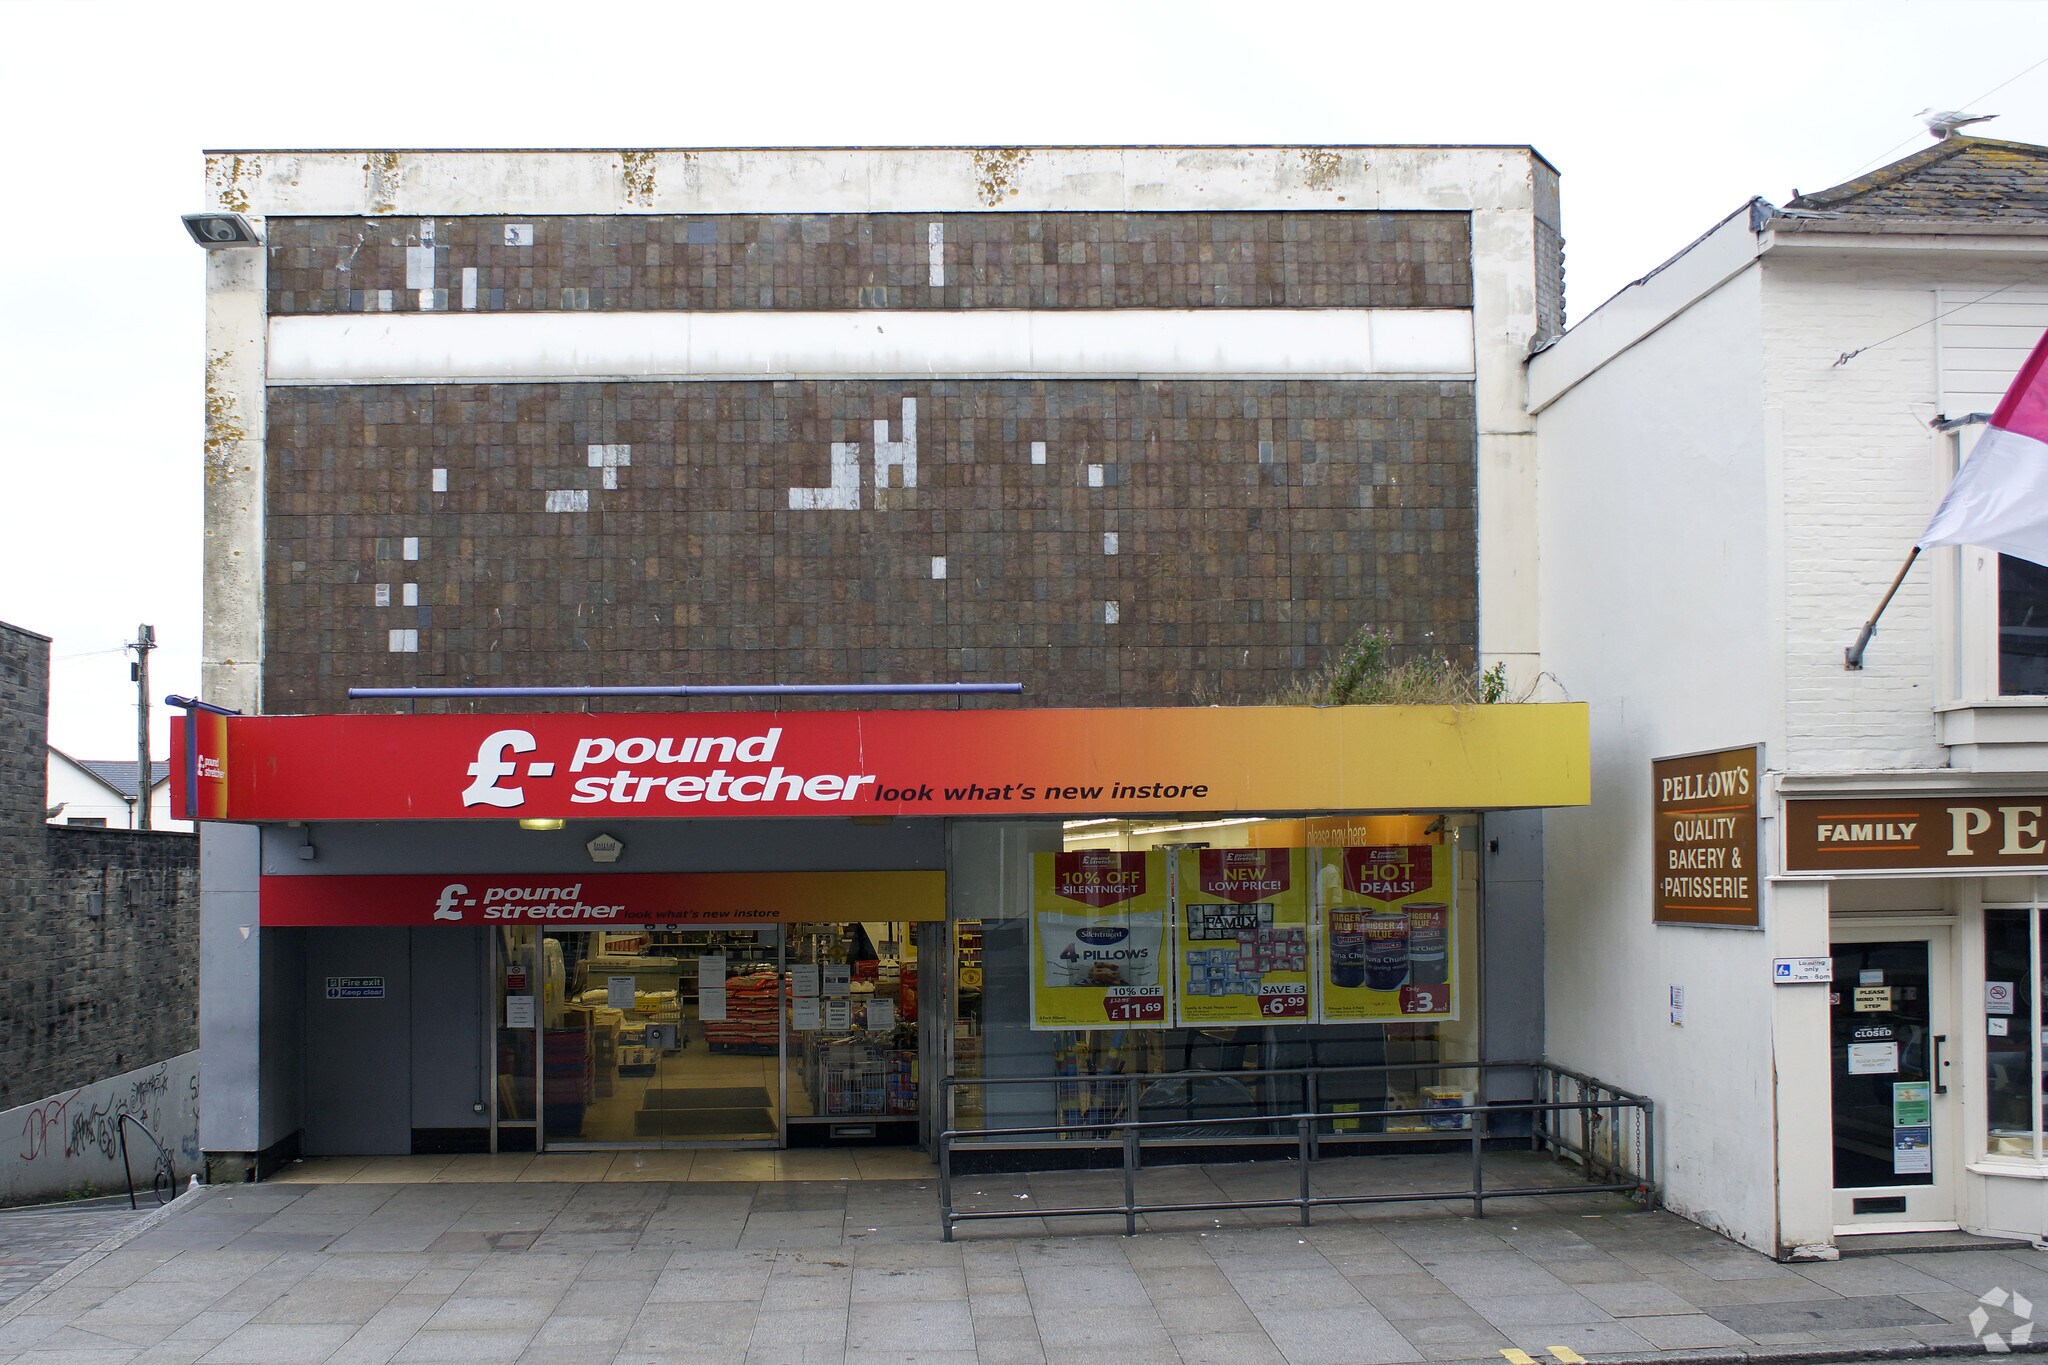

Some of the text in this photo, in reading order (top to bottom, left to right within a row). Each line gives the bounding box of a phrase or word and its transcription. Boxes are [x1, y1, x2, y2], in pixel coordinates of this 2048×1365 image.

[569, 727, 783, 773] pound
[570, 766, 876, 804] stretcher
[874, 782, 1209, 802] look what's new instore
[1662, 766, 1749, 802] PELLOW'S
[1347, 819, 1367, 846] here
[1673, 817, 1736, 842] QUALITY
[1817, 823, 1918, 842] FAMILY
[1668, 846, 1742, 870] BAKERY &
[1062, 871, 1140, 885] 10% OFF
[1223, 868, 1267, 881] NEW
[1360, 863, 1415, 881] HOT
[483, 883, 582, 905] pound
[1063, 885, 1138, 894] SILENTNIGHT
[1208, 880, 1281, 891] LOW PRICE!
[1360, 881, 1415, 894] DEALS!
[1664, 876, 1749, 899] PATISSERIE
[484, 901, 626, 920] stretcher
[624, 908, 780, 919] look what's new instore
[1204, 916, 1257, 929] FAMILY
[1334, 922, 1358, 931] VALUE
[1396, 920, 1404, 931] 4
[1368, 930, 1393, 939] VALUE
[1059, 942, 1149, 963] 4 PILLOWS
[363, 978, 381, 986] exit
[1262, 985, 1306, 994] SAVE £3
[341, 989, 362, 997] Keep
[1113, 987, 1160, 996] 10% OFF
[1111, 1002, 1162, 1019] £11.69
[1262, 996, 1306, 1014] £6.99
[1407, 992, 1434, 1012] £3
[1854, 1029, 1892, 1038] CLOSED
